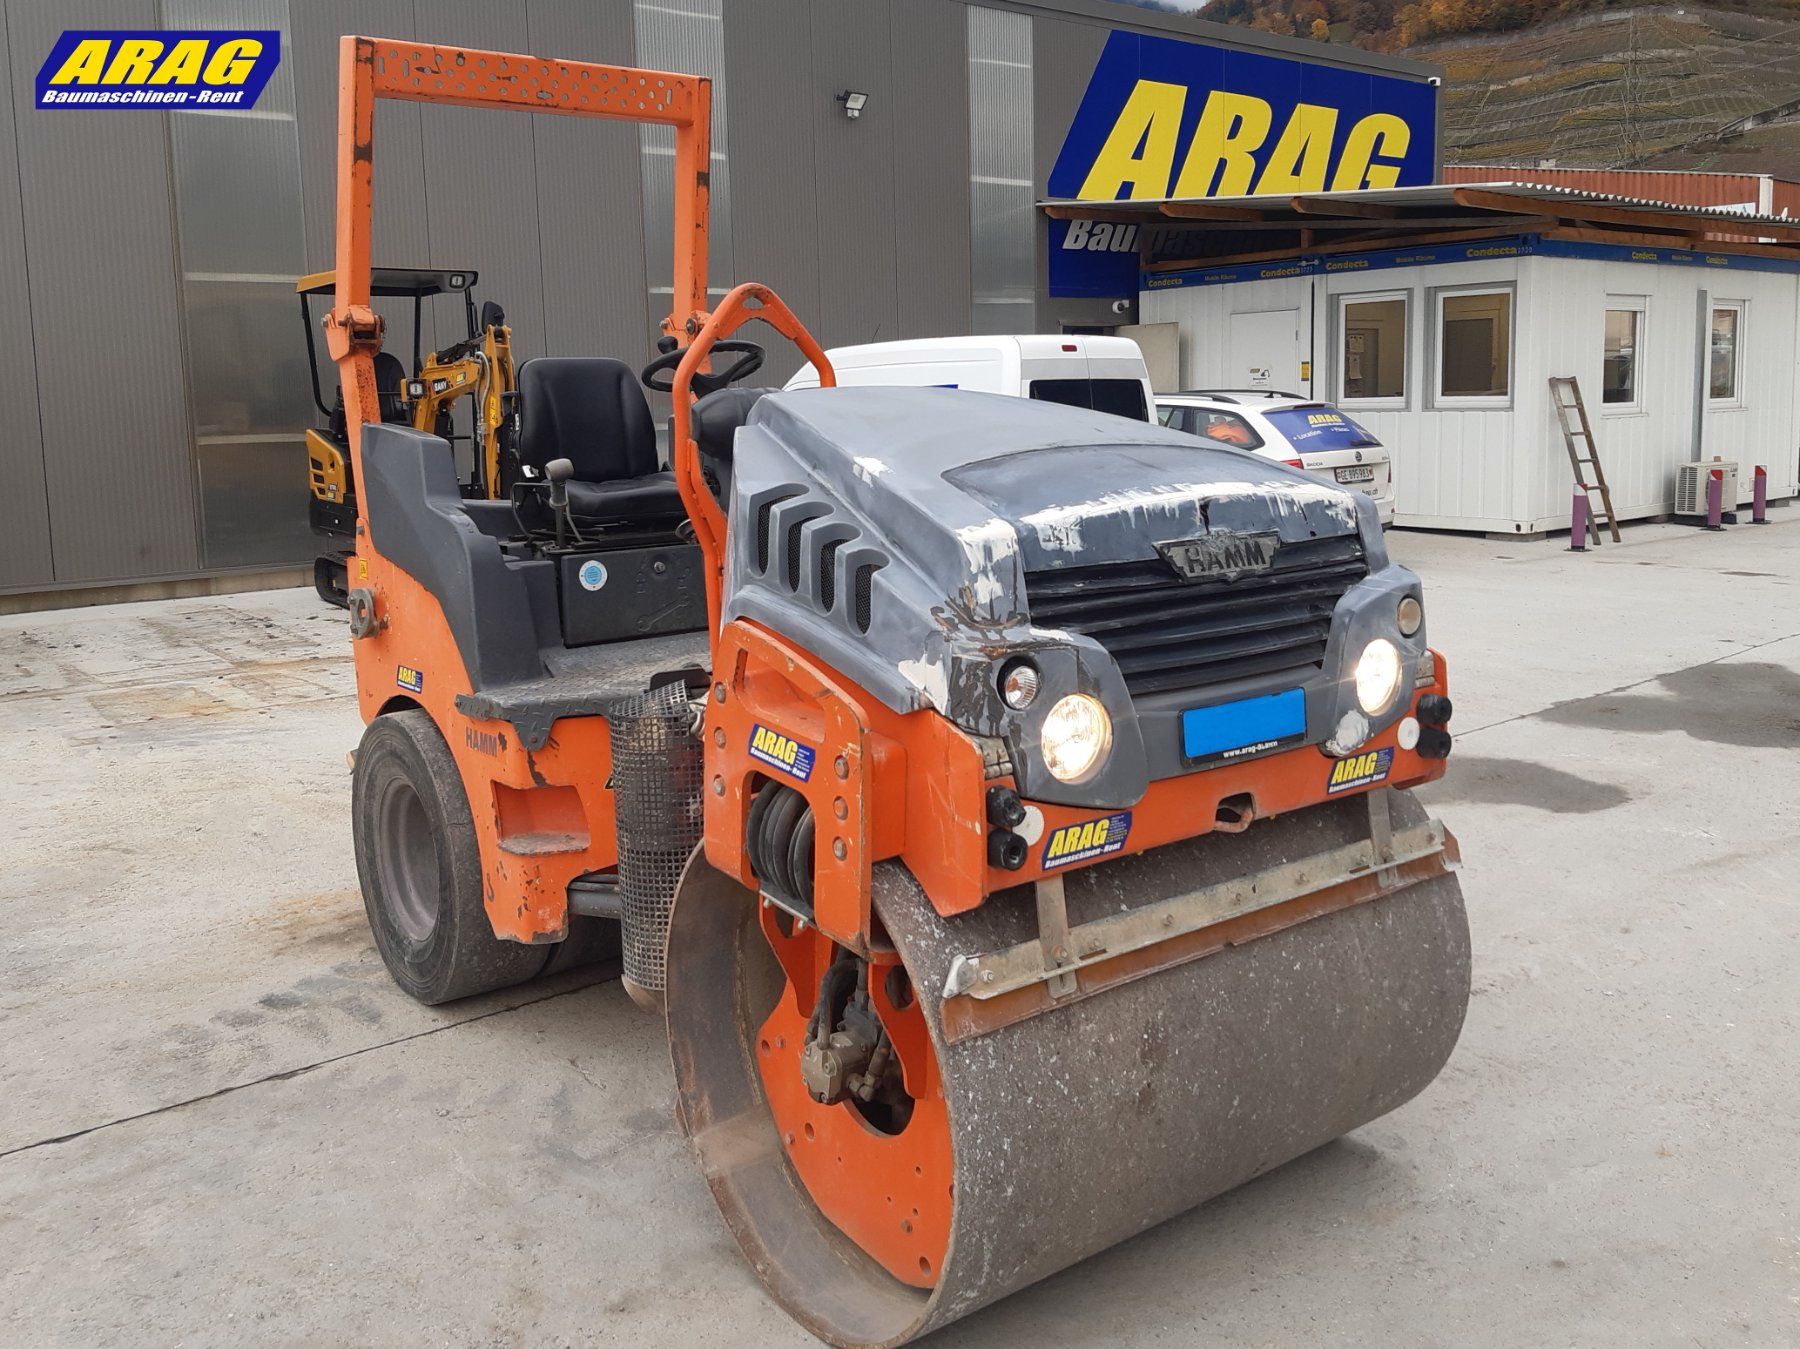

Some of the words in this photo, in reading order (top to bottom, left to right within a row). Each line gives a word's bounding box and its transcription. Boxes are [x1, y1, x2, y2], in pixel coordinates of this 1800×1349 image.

[1076, 79, 1411, 200] ARAG
[1466, 247, 1517, 257] Condecta
[1260, 266, 1300, 278] Condecta
[1325, 260, 1369, 271] Condecta
[1148, 278, 1183, 288] Condecta
[1308, 414, 1343, 425] ARAG
[1185, 540, 1267, 574] HAMM
[398, 666, 416, 685] ARAG
[465, 726, 498, 758] HAMM
[752, 726, 798, 765] ARAG
[1330, 751, 1378, 784] ARAG
[1047, 818, 1110, 858] ARAG
